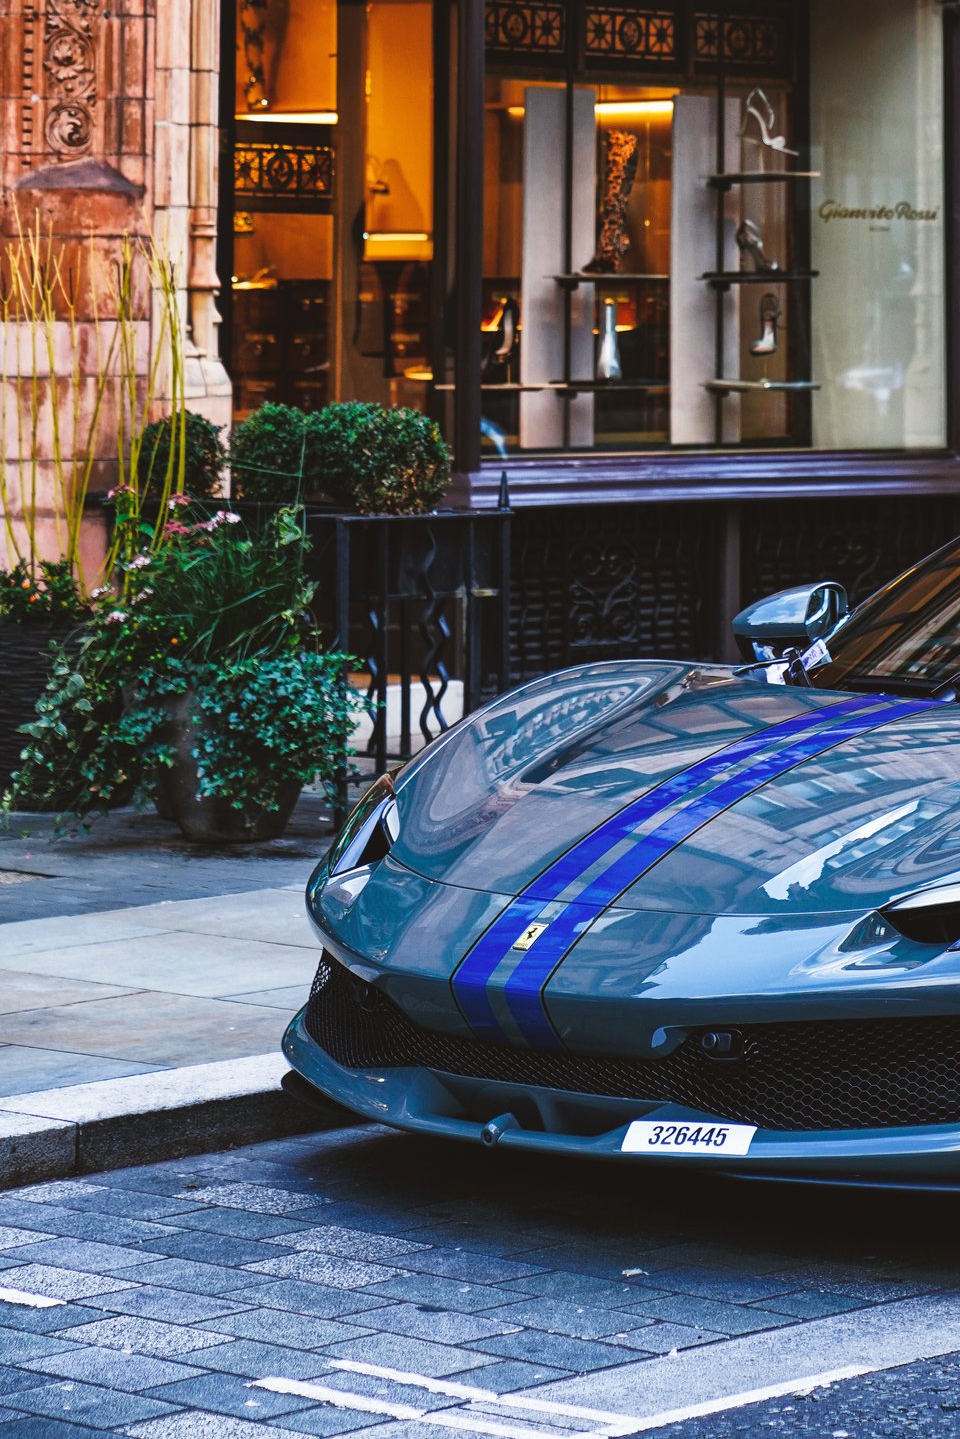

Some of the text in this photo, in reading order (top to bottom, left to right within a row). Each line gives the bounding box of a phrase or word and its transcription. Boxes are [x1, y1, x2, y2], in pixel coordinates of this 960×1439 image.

[819, 199, 939, 223] Gianvito Rossi
[648, 1125, 729, 1147] 326445
